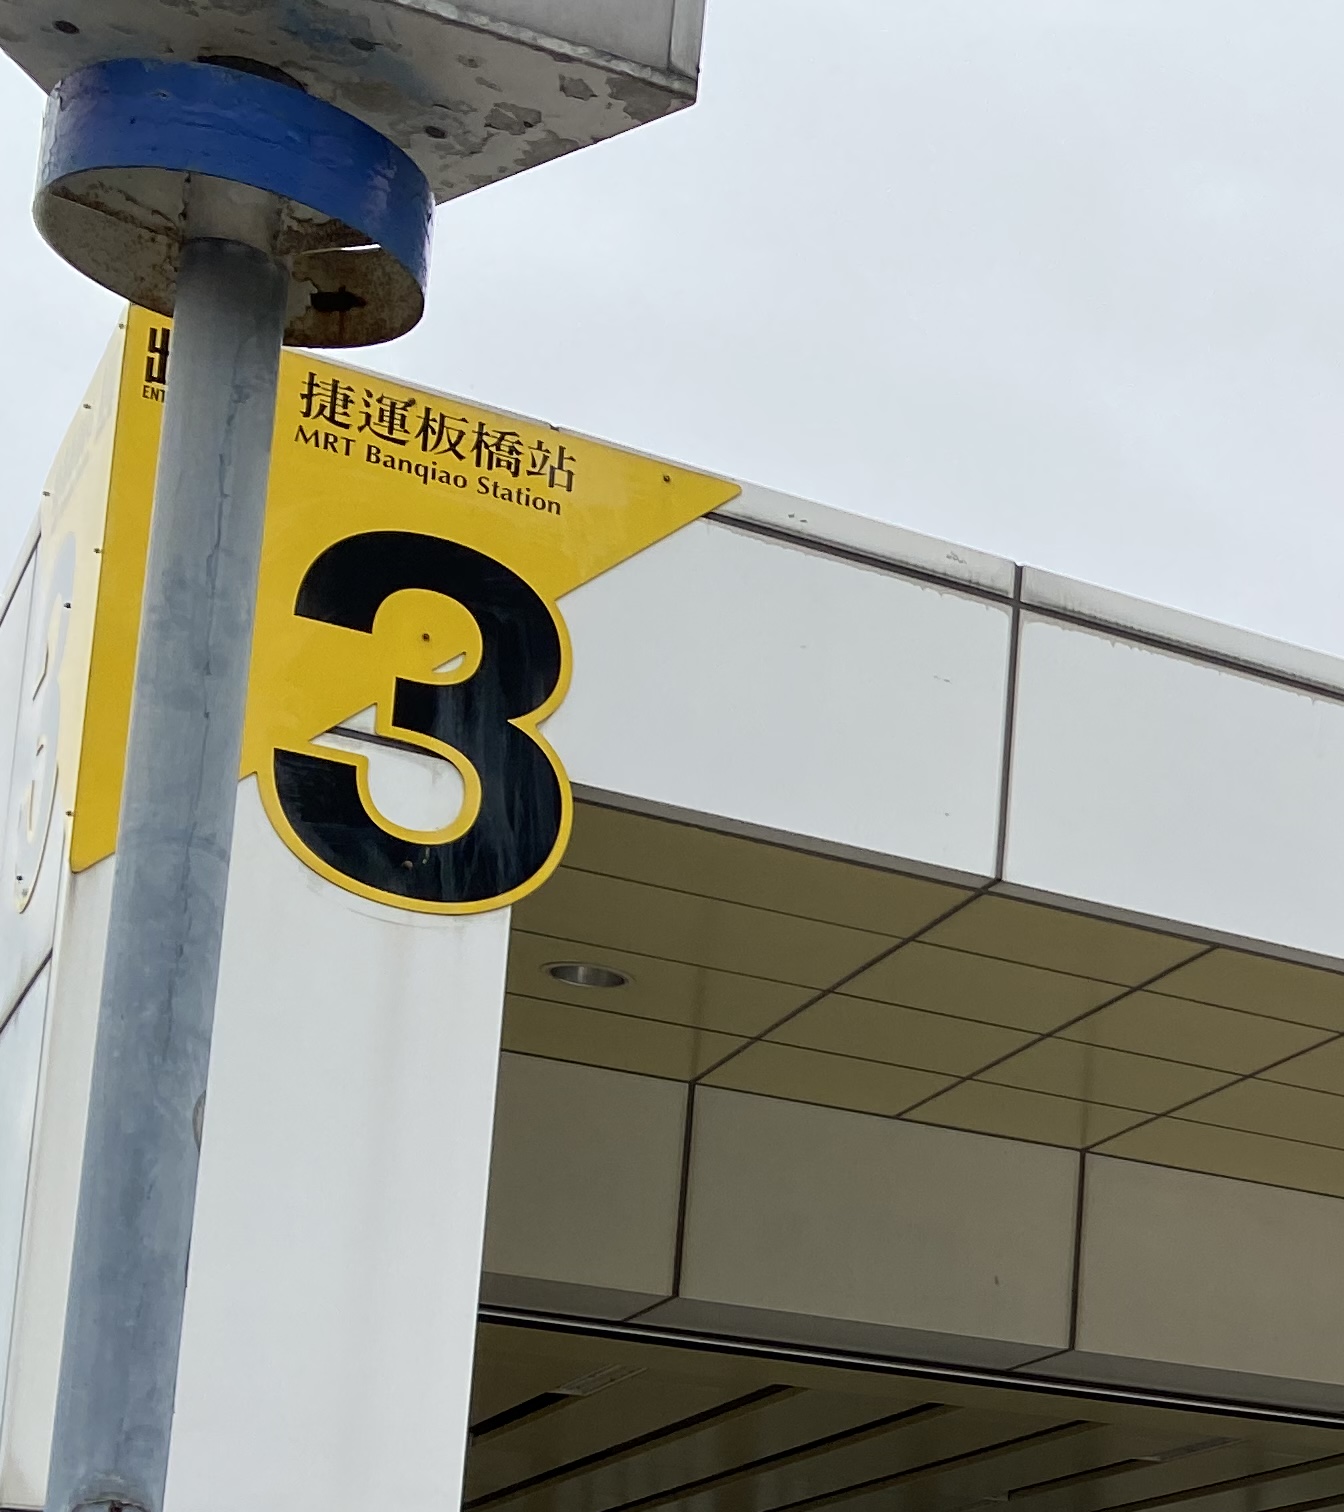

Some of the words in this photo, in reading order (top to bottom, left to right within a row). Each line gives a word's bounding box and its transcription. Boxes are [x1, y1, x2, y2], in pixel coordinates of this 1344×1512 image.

[294, 424, 356, 456] MRT
[366, 444, 468, 489] Banqiao
[476, 476, 562, 515] Station
[299, 371, 576, 492] 捷運板橋站
[273, 531, 562, 901] 3
